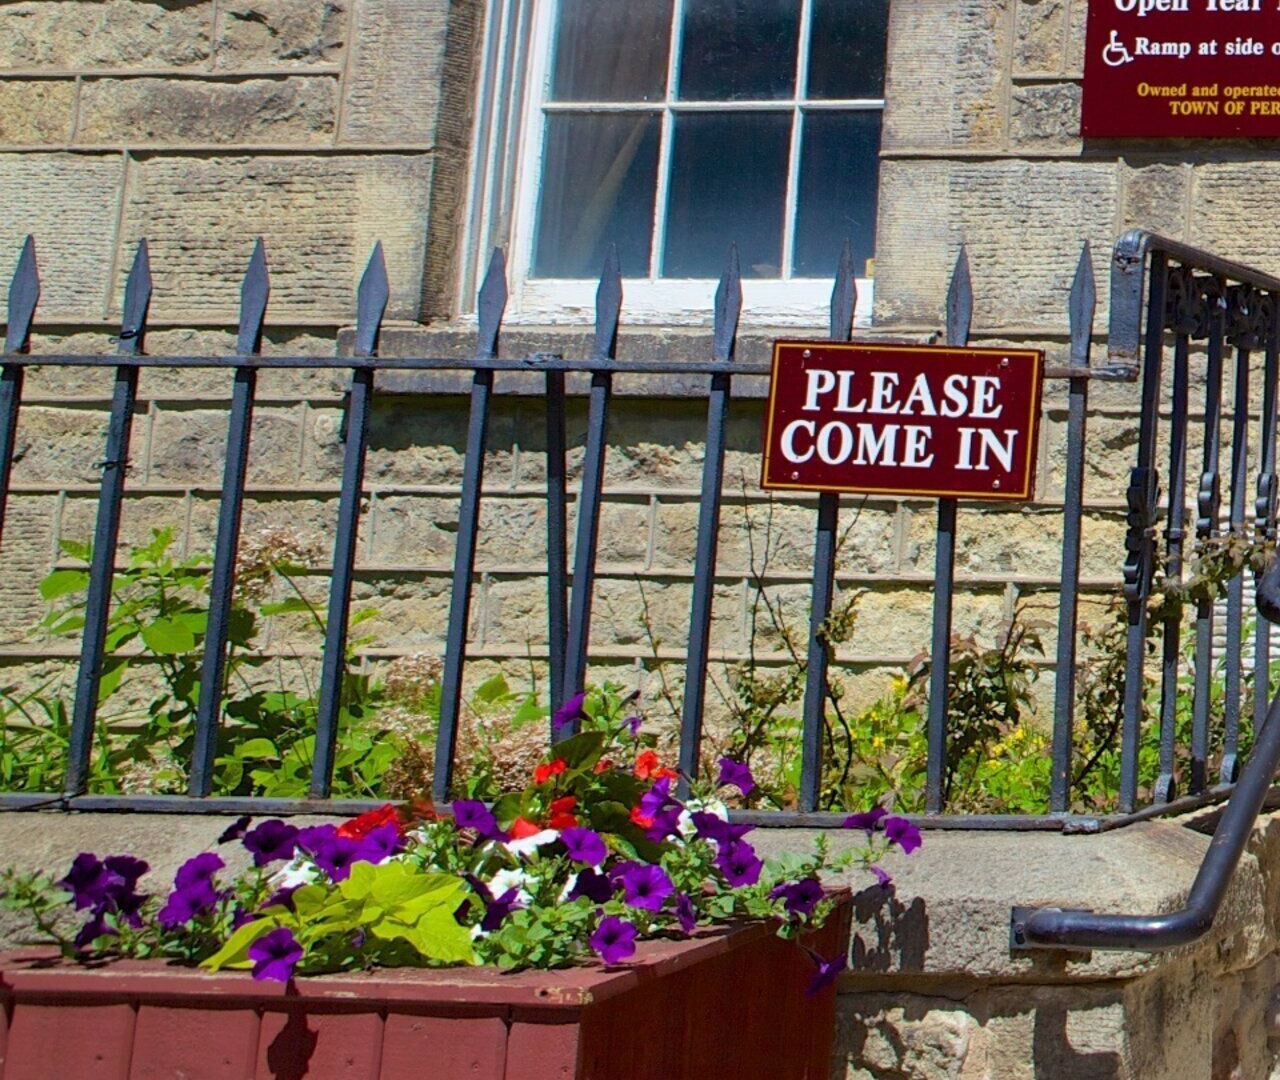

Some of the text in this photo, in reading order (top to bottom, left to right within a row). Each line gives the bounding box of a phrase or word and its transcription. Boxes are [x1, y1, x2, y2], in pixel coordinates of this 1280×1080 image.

[1135, 37, 1191, 58] Ramp
[1199, 40, 1217, 55] at
[1225, 38, 1263, 55] side
[1138, 83, 1186, 96] Owned
[1193, 84, 1217, 95] and
[1170, 102, 1218, 114] TOWN
[1225, 102, 1244, 114] OF
[802, 369, 1002, 418] PLEASE
[781, 420, 1018, 472] COME IN
